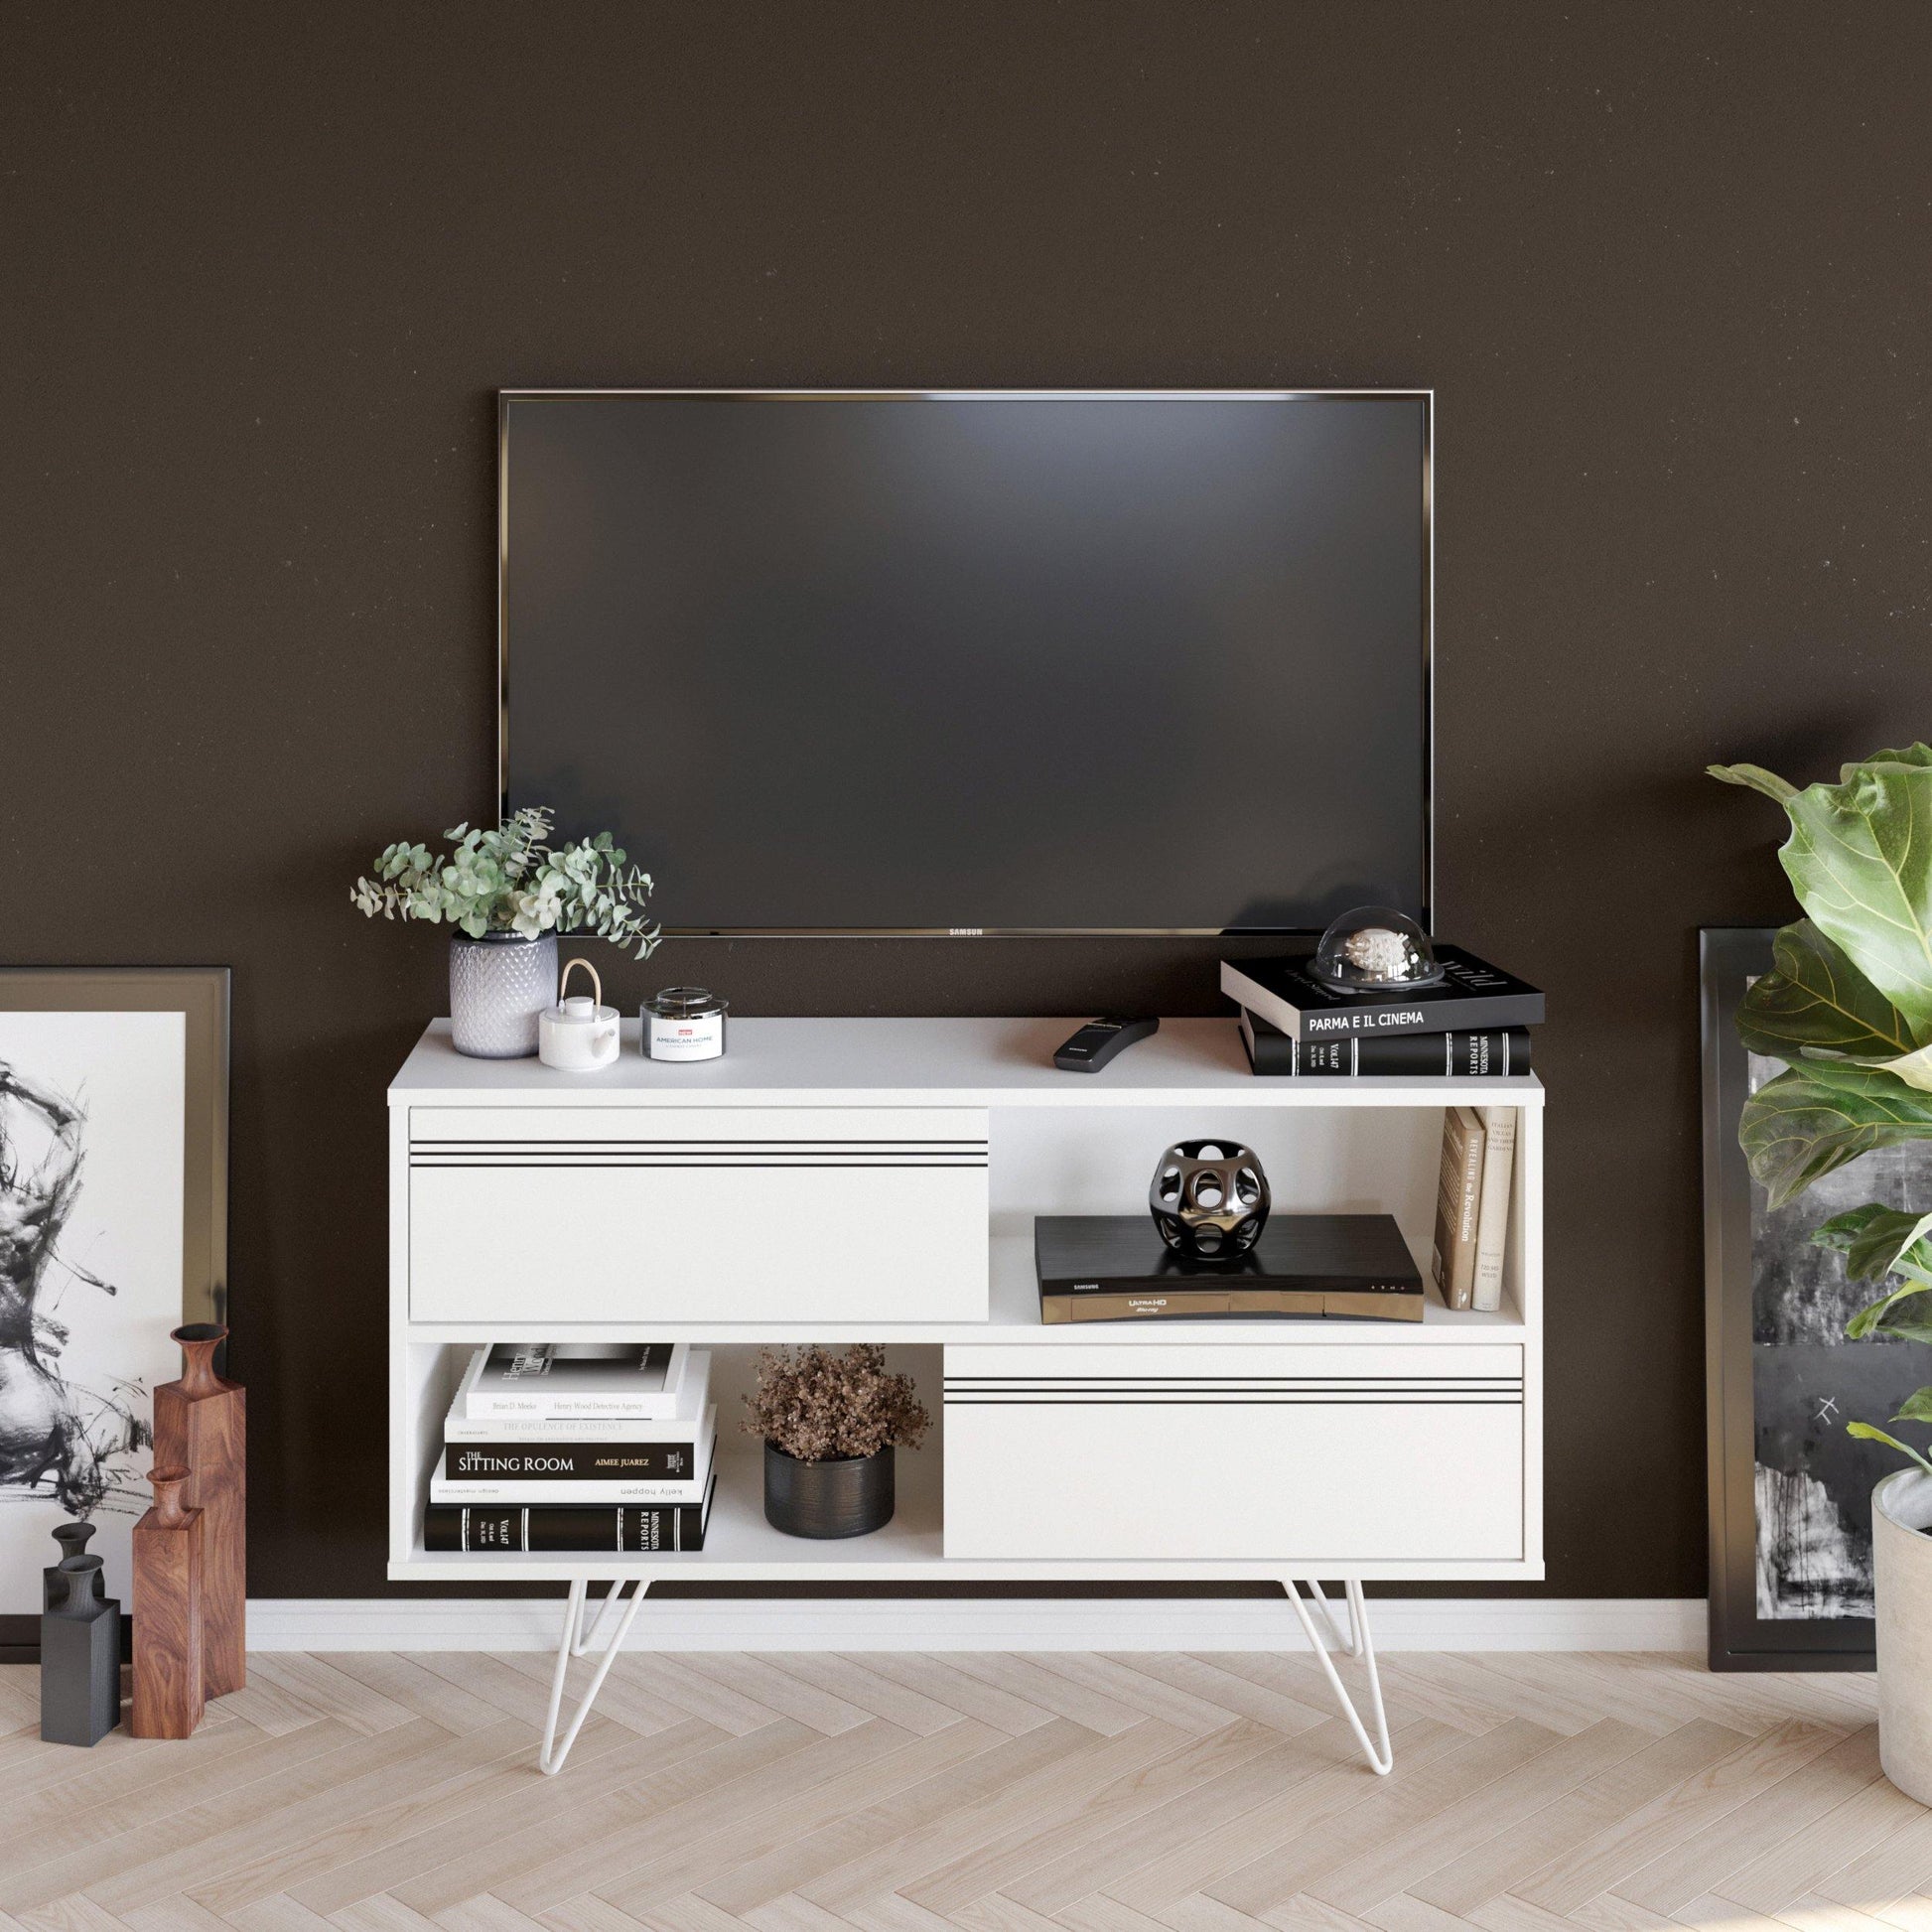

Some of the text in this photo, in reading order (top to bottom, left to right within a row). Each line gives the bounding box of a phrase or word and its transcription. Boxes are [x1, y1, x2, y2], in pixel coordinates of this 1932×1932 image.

[1309, 1011, 1425, 1032] PARMA E IL CINEMA
[1469, 1035, 1478, 1075] REPORTS
[1479, 1035, 1488, 1074] MINNESOTA
[1466, 1139, 1478, 1180] REVEALING
[1461, 1194, 1474, 1242] Revolution
[501, 1352, 526, 1381] Henry
[554, 1402, 573, 1411] Henry
[621, 1402, 643, 1411] Agency
[459, 1456, 520, 1471] SITTING
[524, 1457, 574, 1471] ROOM
[621, 1458, 649, 1467] JUAREZ
[640, 1511, 649, 1551] REPORTS
[650, 1511, 659, 1550] MINNESOTA
